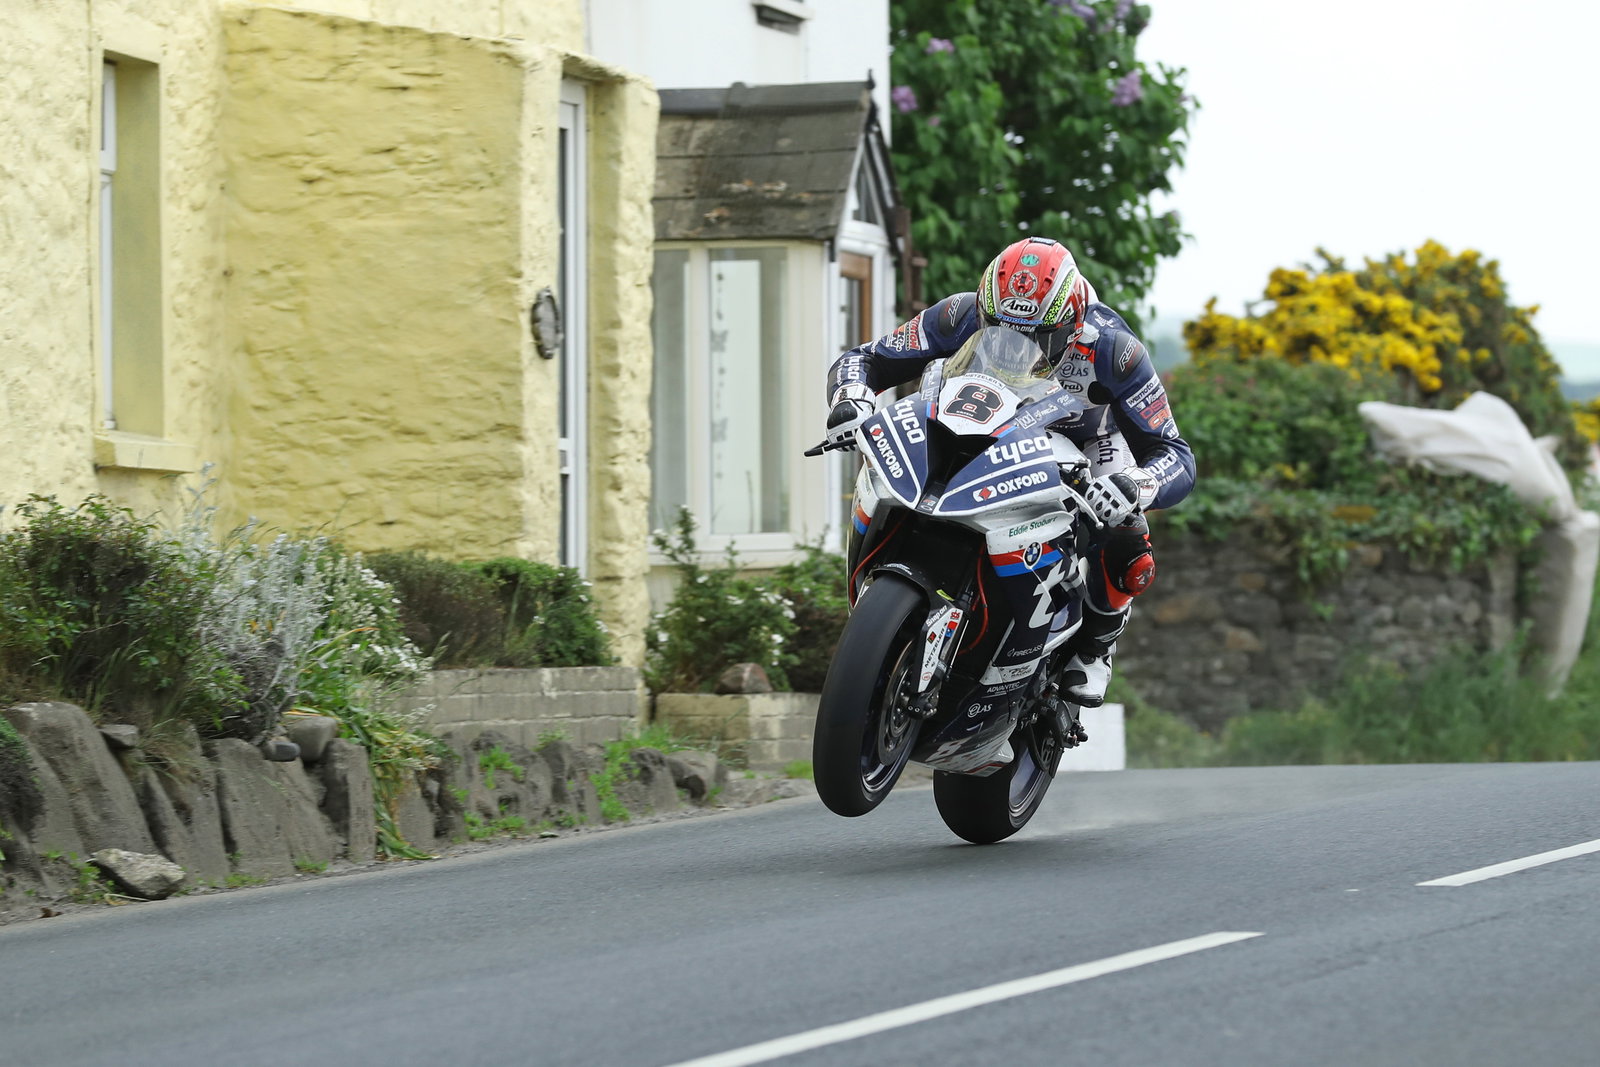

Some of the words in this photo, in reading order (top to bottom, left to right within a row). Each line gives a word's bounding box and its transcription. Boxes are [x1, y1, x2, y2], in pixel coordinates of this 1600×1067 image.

[1006, 299, 1034, 314] Arai
[1068, 352, 1088, 362] yco
[943, 381, 1004, 425] 8
[892, 399, 926, 444] tyco
[876, 438, 904, 479] OXFORD
[984, 436, 1053, 465] tyco
[996, 471, 1049, 495] OXFORD
[1008, 526, 1029, 538] Eddie
[1029, 516, 1058, 531] Stobart
[924, 628, 945, 668] METZELER
